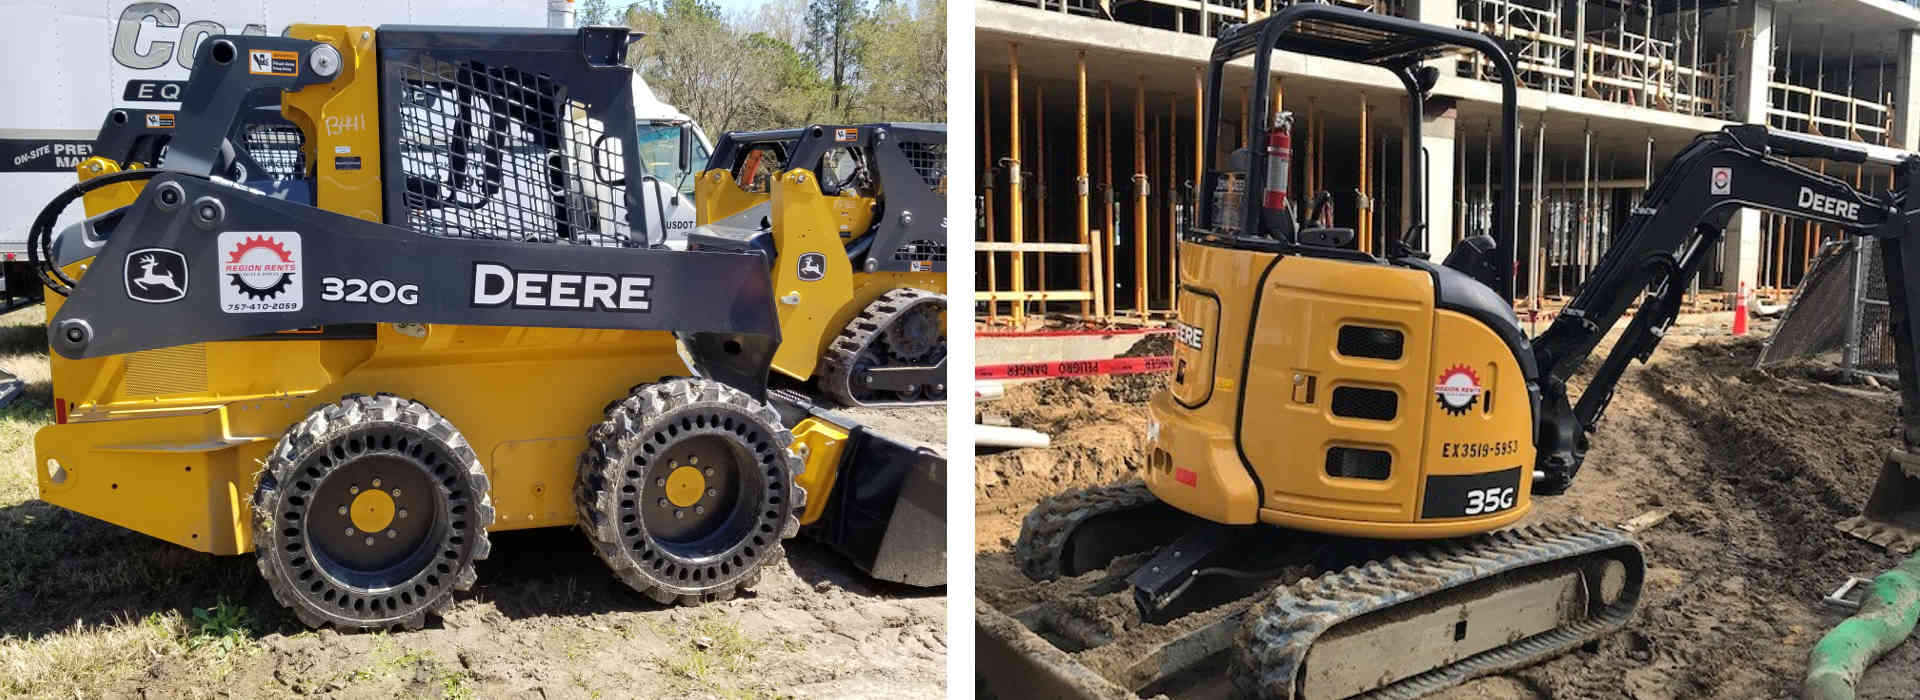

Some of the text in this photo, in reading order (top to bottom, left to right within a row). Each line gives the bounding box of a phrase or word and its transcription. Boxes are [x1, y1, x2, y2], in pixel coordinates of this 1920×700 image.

[14, 144, 50, 166] ON-SITE
[1797, 186, 1862, 221] DEERE
[666, 220, 694, 230] USDOT
[225, 263, 296, 272] REGION RENTS
[321, 277, 418, 305] 320G
[474, 263, 651, 310] DEERE
[227, 302, 297, 311] 757-410-2059
[1007, 363, 1049, 376] DANGER
[1058, 361, 1099, 373] PELIGRO
[1465, 487, 1514, 515] 35G
